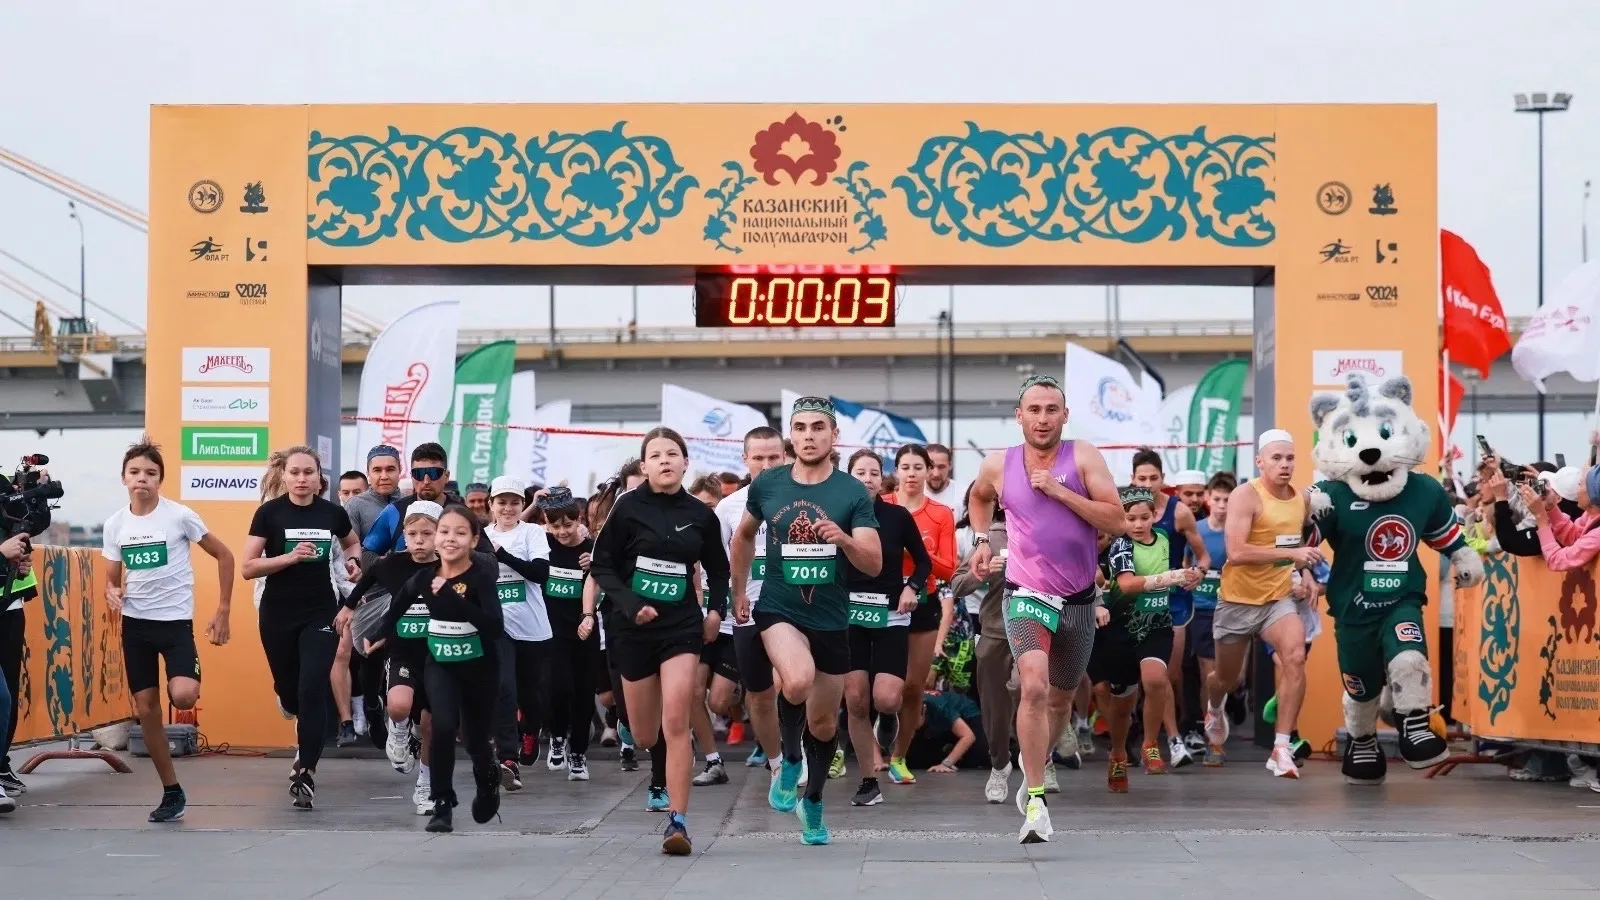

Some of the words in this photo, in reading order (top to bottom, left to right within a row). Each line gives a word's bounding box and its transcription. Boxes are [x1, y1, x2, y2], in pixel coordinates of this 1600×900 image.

[743, 196, 848, 213] КАЗАНСКИЙ
[743, 215, 848, 228] НАЦИОНАЛЬНЫЙ
[743, 231, 848, 247] ПОЛУМАРАФОН
[239, 283, 267, 298] 2024
[1370, 286, 1397, 300] 2024
[728, 278, 890, 323] 0:00:03
[191, 478, 258, 489] DIGINAVIS
[127, 551, 160, 565] 7633
[790, 566, 828, 579] 7016
[550, 583, 575, 595] 7461
[641, 578, 678, 596] 7173
[1196, 583, 1214, 593] 627
[1370, 578, 1401, 588] 8500
[497, 588, 519, 600] 685
[1144, 595, 1168, 608] 7858
[850, 610, 880, 623] 7626
[1016, 601, 1050, 624] 8008
[434, 643, 473, 657] 7832
